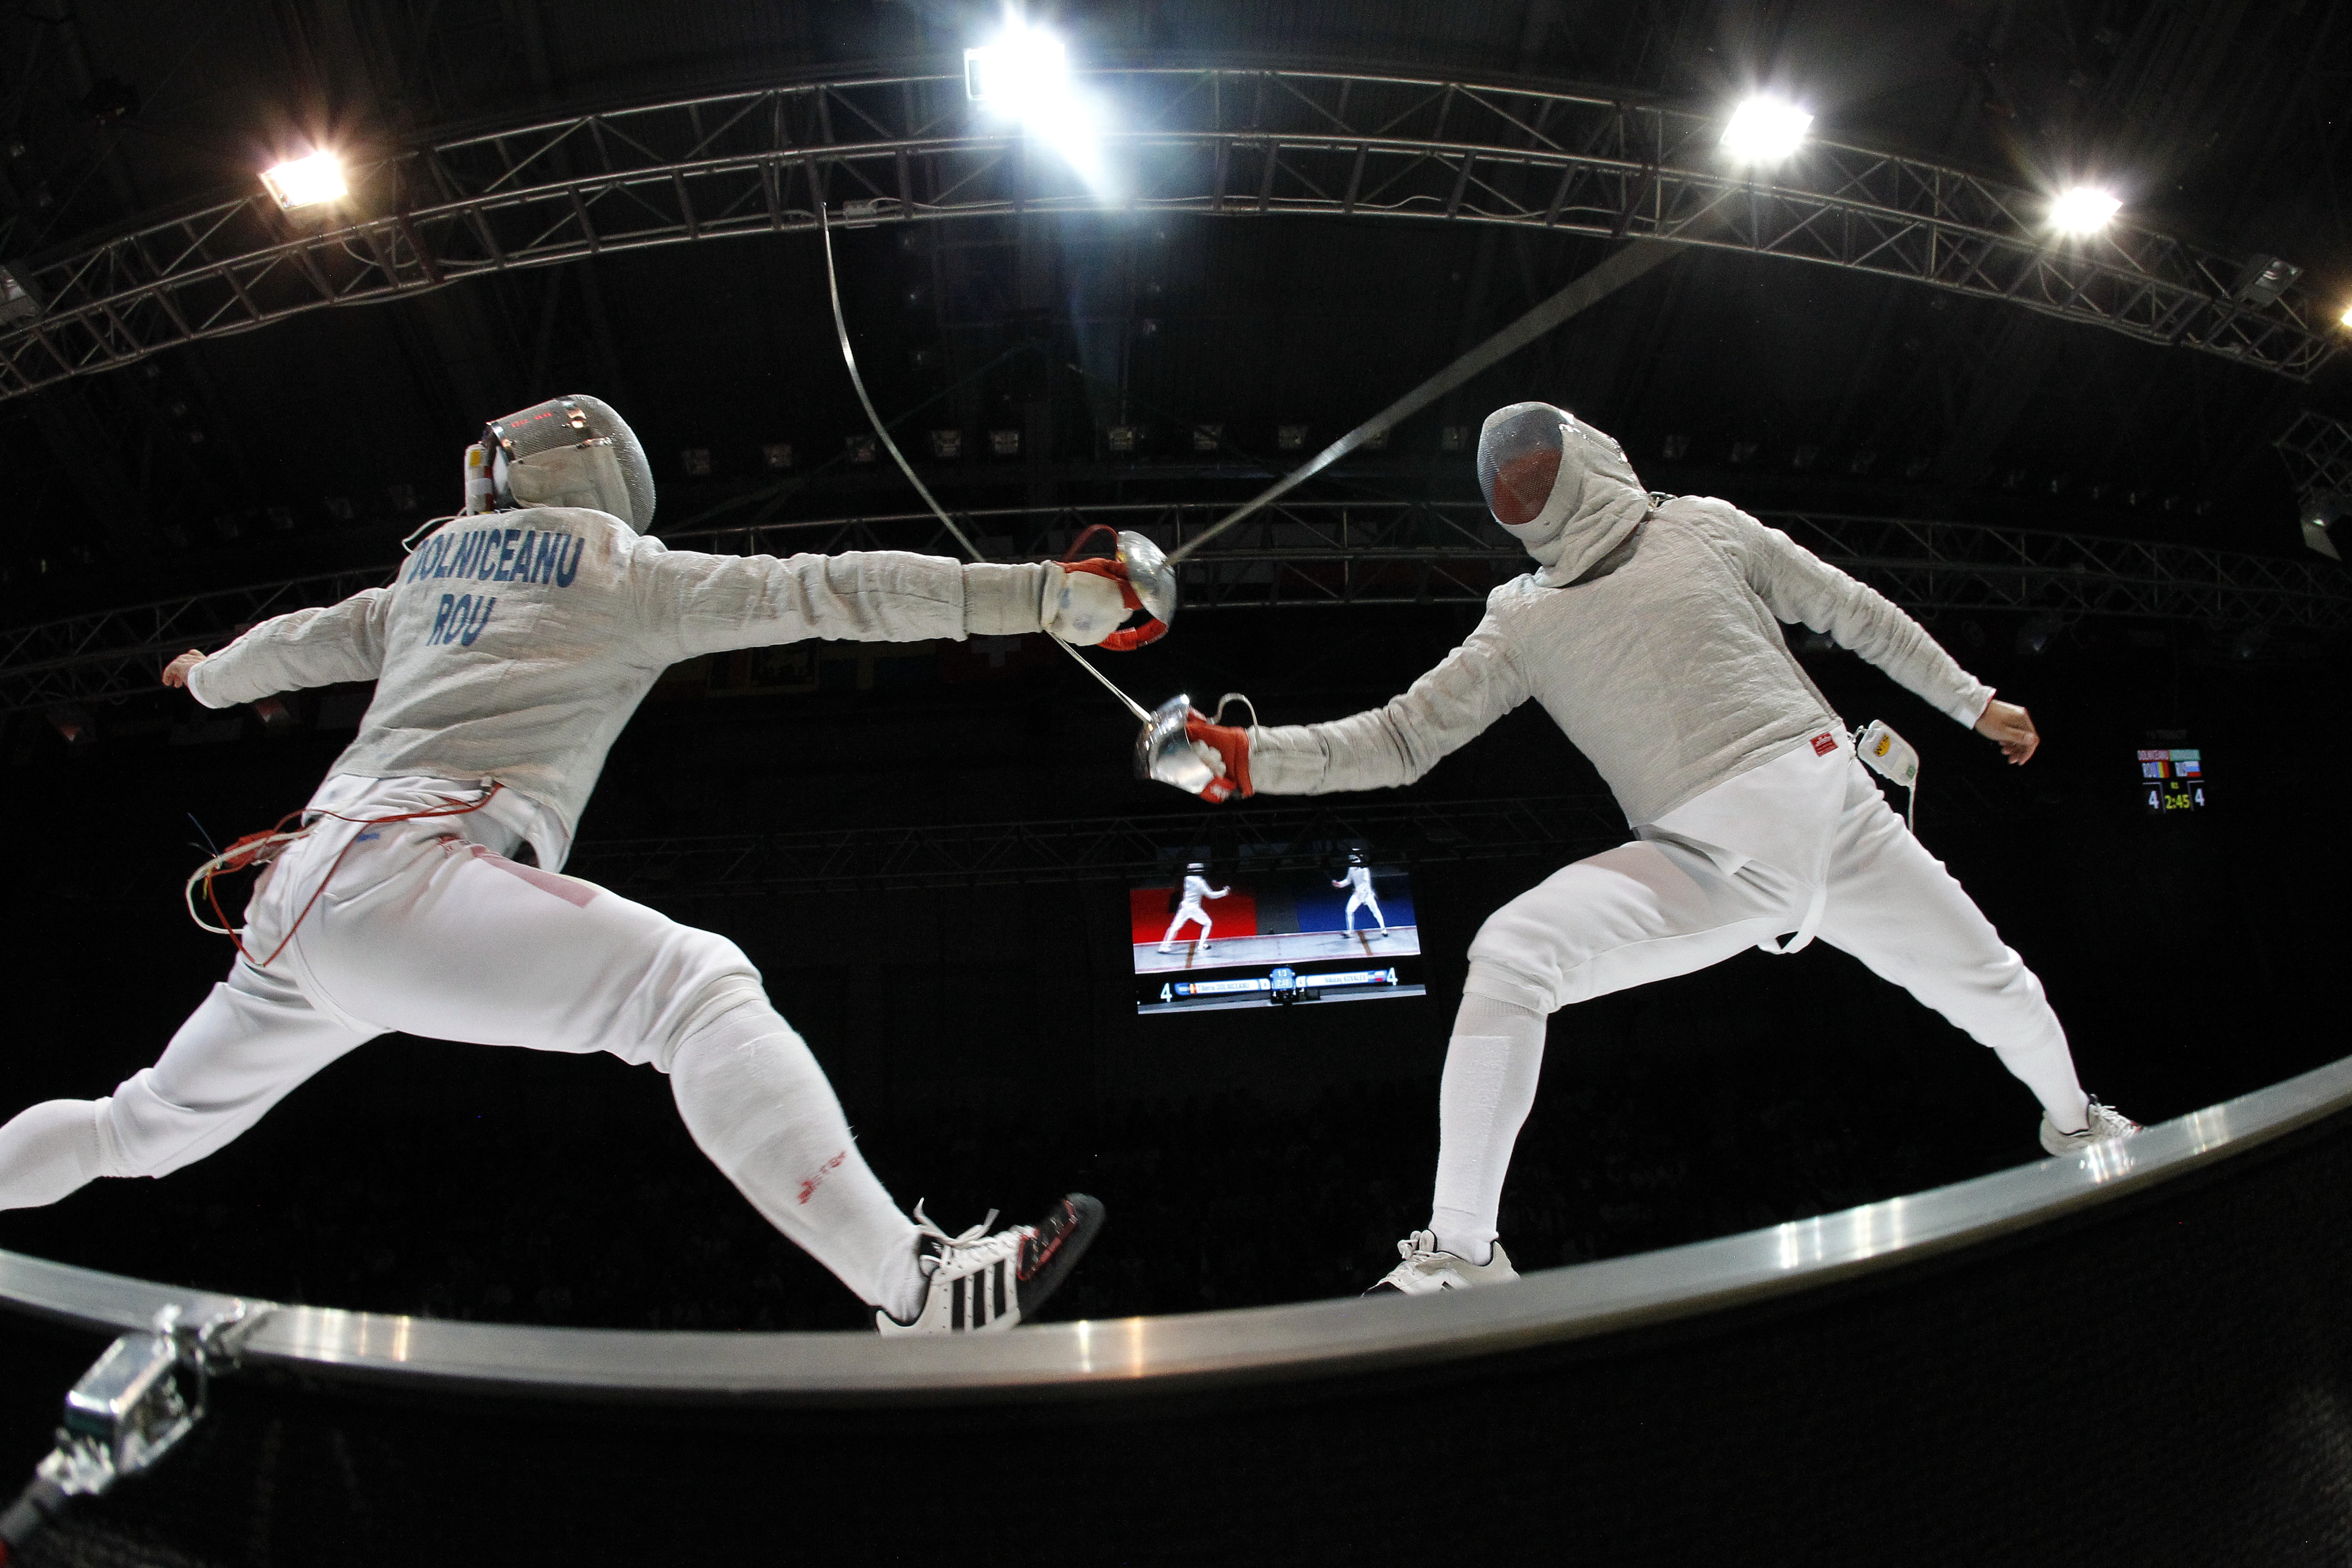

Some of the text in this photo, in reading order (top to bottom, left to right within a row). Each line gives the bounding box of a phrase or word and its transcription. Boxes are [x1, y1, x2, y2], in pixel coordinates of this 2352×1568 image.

[426, 594, 497, 646] ROU
[2148, 790, 2159, 809] 4
[2165, 794, 2191, 809] 2:45
[2194, 788, 2205, 806] 4
[1387, 967, 1398, 986] 4
[1161, 983, 1173, 1003] 4
